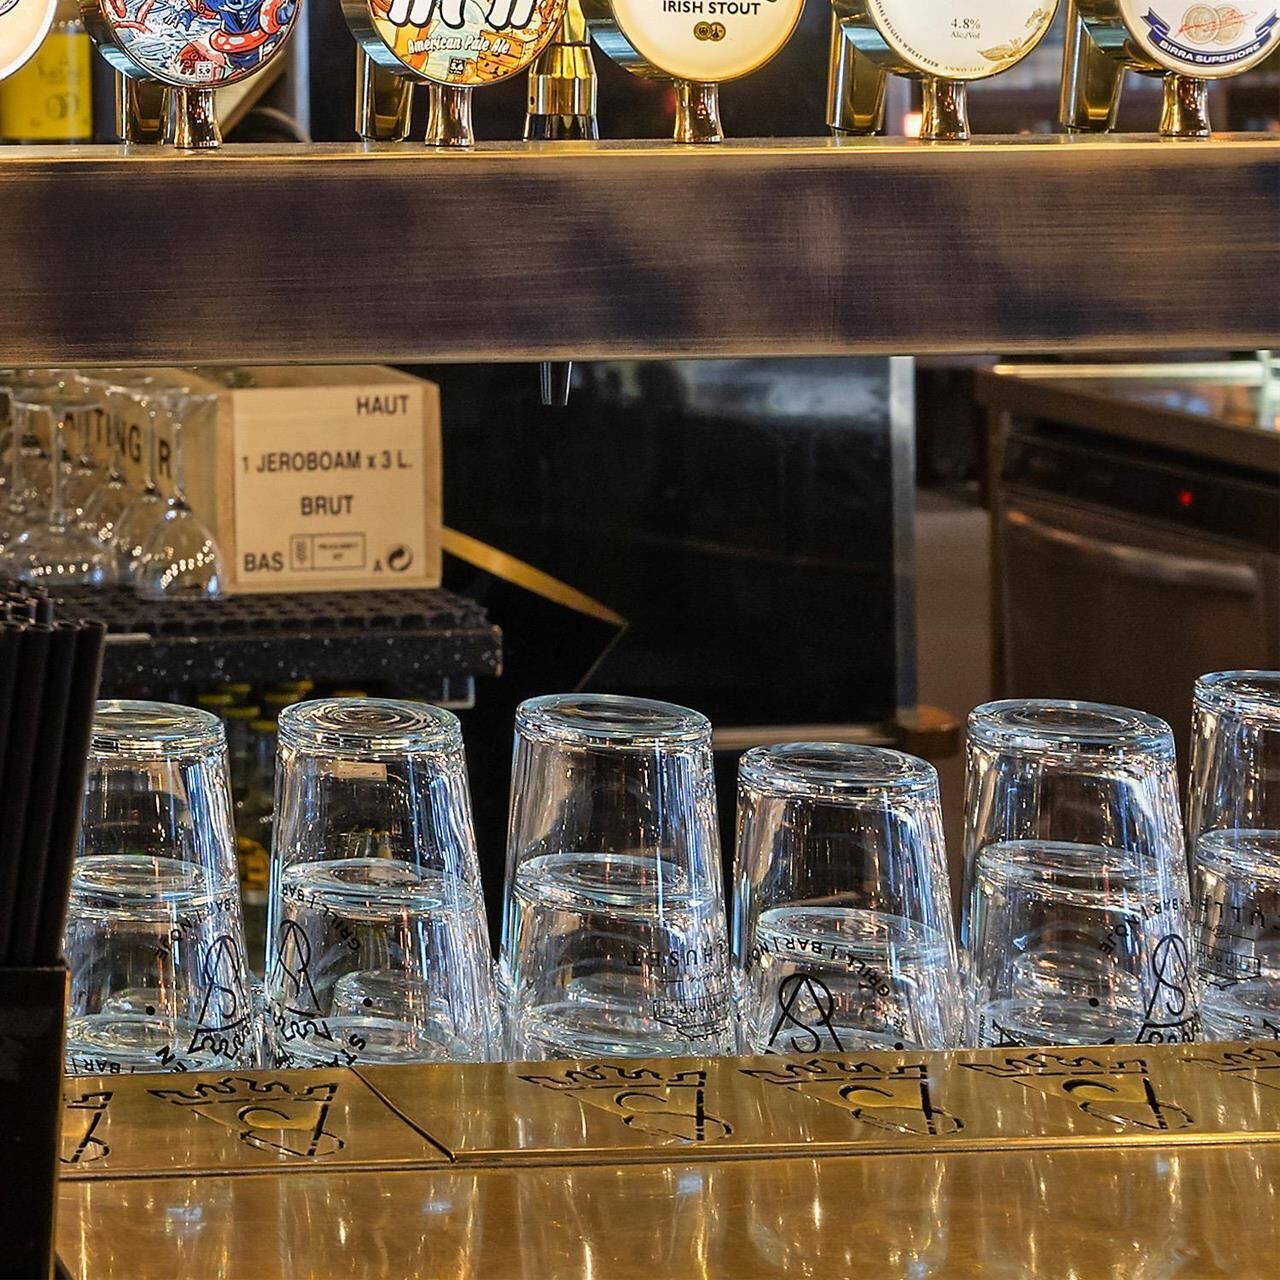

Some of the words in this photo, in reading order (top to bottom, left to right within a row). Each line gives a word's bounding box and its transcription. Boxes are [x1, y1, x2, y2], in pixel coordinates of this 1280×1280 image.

[663, 0, 703, 14] IRISH
[708, 1, 761, 15] STOUT
[951, 18, 981, 30] 4.8%
[407, 34, 461, 55] American
[462, 35, 490, 51] Pale
[490, 37, 511, 56] Ale
[902, 41, 924, 61] WHEAT
[923, 56, 940, 68] BEER
[1159, 39, 1194, 62] BIRRA
[1195, 42, 1262, 64] SUPERIORE
[356, 394, 410, 416] HAUT
[243, 455, 249, 474] 1
[256, 450, 362, 473] JEROBOAM
[381, 450, 392, 469] 3
[300, 494, 354, 516] BRUT
[243, 551, 284, 572] BAS
